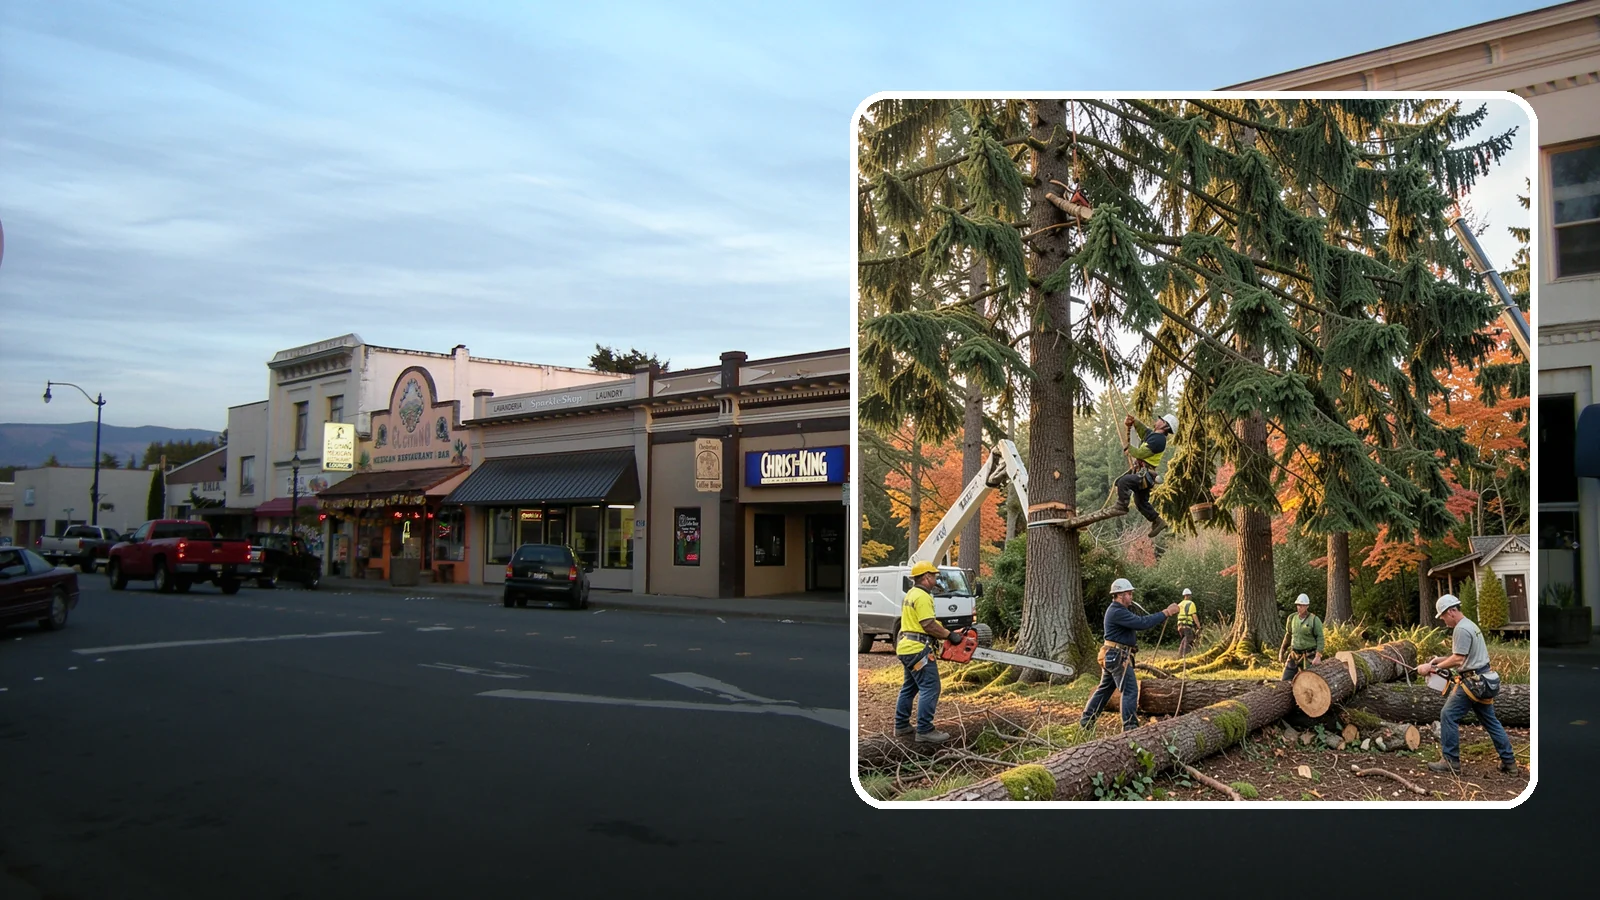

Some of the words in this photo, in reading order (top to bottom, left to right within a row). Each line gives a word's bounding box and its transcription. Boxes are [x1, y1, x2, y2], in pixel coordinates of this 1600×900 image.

[562, 393, 583, 404] Shop
[595, 389, 624, 400] LAUNDRY
[373, 456, 396, 465] MEXICAN
[397, 451, 433, 463] RESTAURANT
[437, 450, 450, 459] BAR
[761, 452, 797, 478] CHRIST
[799, 450, 827, 477] KING
[696, 480, 709, 489] Coffee
